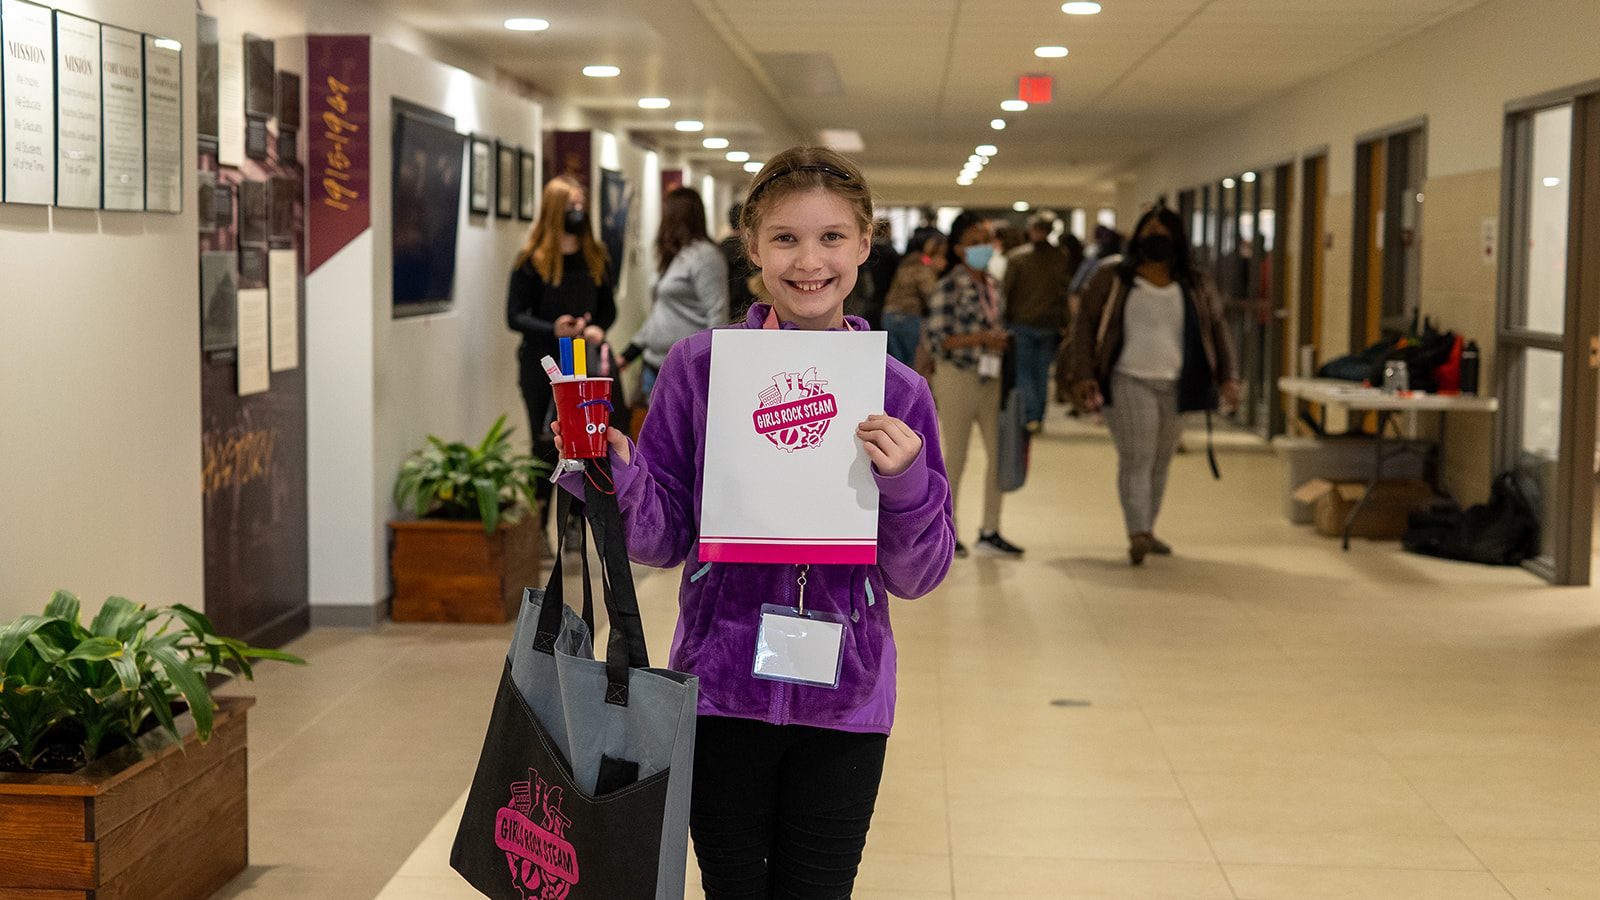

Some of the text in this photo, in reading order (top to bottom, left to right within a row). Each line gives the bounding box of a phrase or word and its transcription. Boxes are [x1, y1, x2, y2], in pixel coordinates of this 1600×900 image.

[8, 40, 46, 64] MISSION
[64, 54, 93, 76] MISIÓN
[757, 398, 834, 429] GIRLS ROCK STEAM
[501, 816, 574, 876] GIRLS ROCK STEAM
